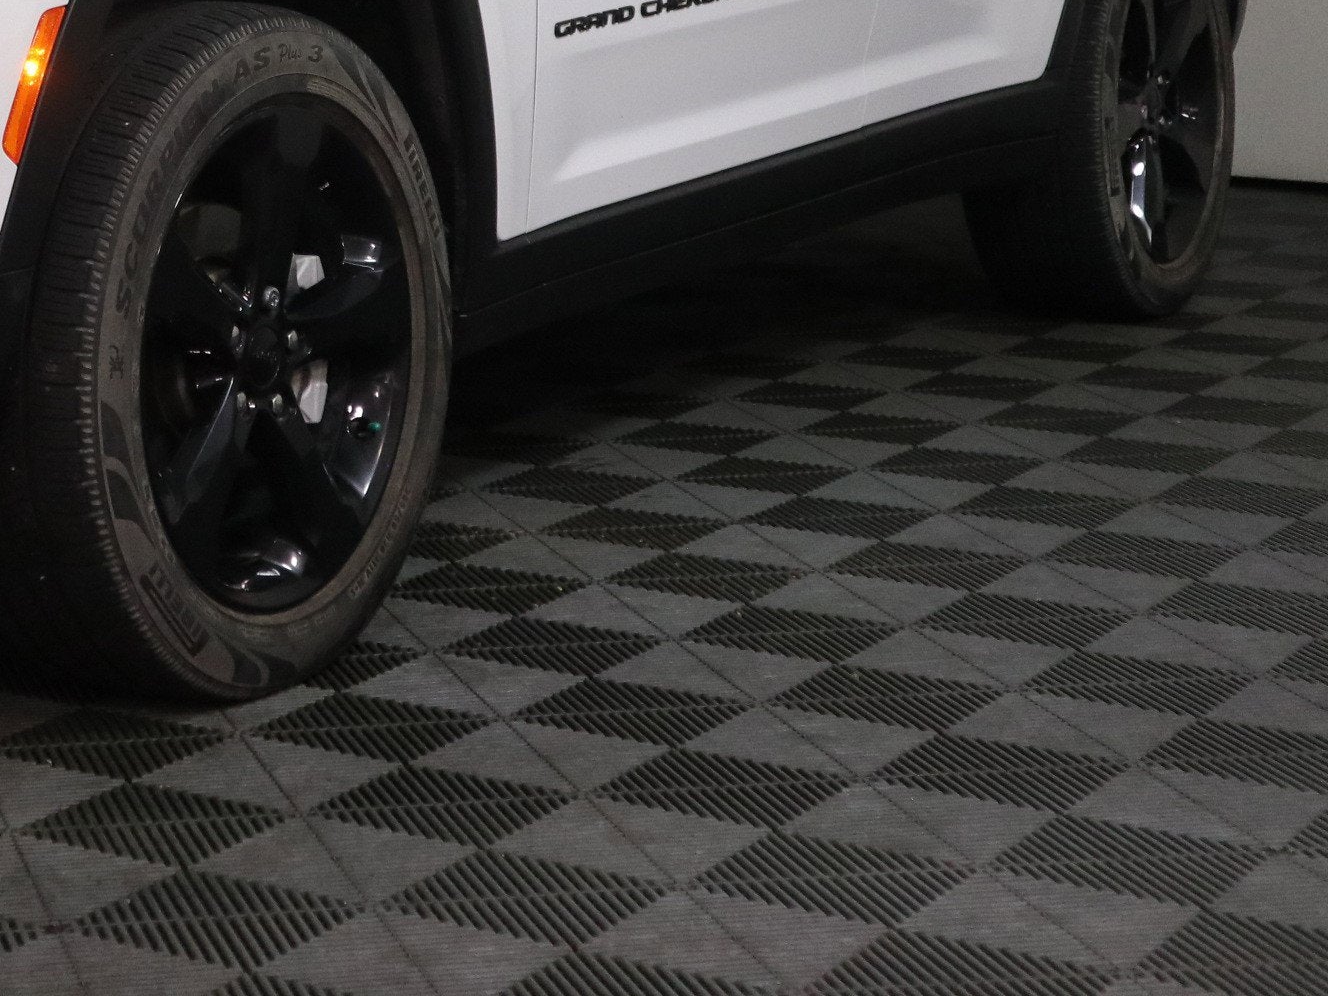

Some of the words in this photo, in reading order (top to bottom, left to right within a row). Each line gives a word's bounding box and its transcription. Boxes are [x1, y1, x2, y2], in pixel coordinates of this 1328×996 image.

[554, 5, 635, 38] GRAND
[232, 45, 271, 85] AS
[308, 44, 324, 63] 3
